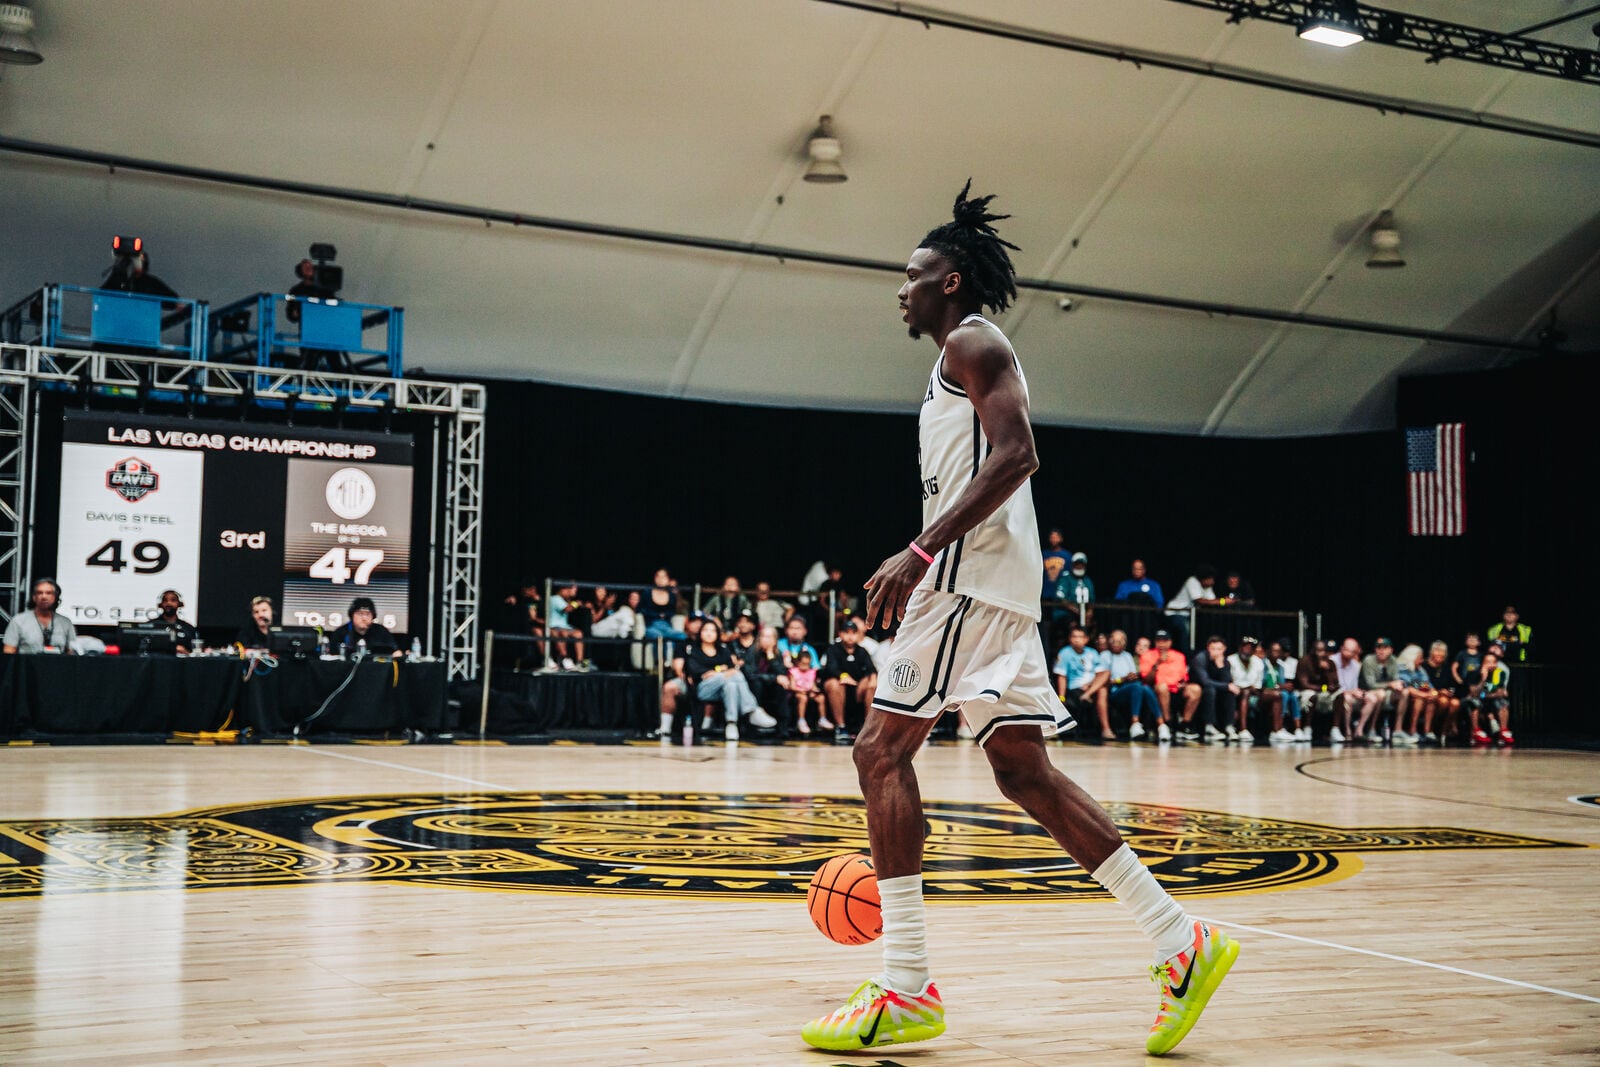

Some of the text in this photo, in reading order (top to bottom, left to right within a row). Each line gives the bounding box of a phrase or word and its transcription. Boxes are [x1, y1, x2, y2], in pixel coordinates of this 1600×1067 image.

[107, 427, 376, 459] LAS VEGAS CHAMPIONSHIP
[86, 510, 174, 525] DAVIS STEEL
[310, 521, 387, 537] THE MECCA
[220, 530, 266, 549] 3rd
[85, 539, 170, 574] 49
[309, 547, 384, 585] 47
[328, 612, 343, 627] 3
